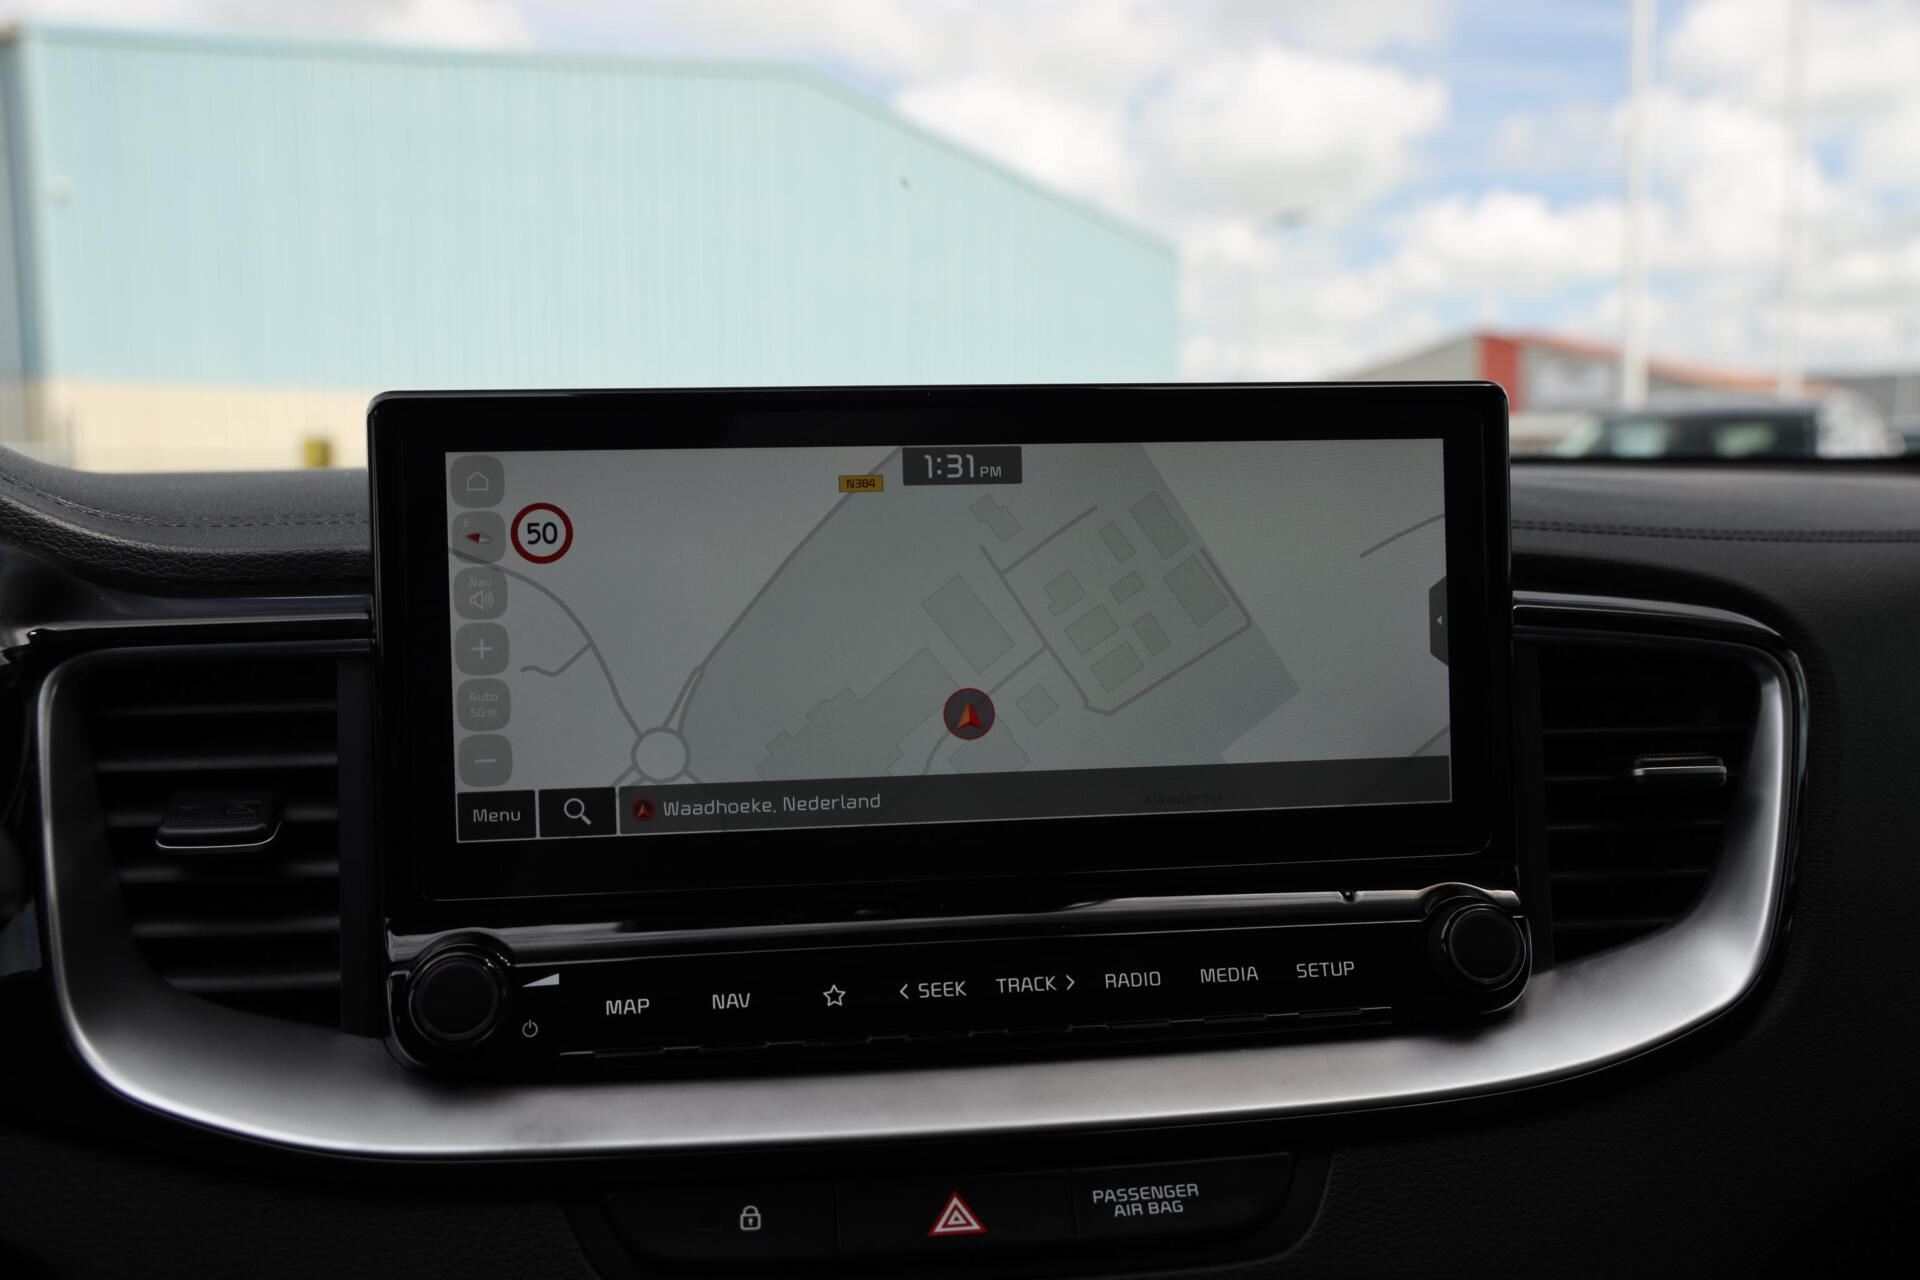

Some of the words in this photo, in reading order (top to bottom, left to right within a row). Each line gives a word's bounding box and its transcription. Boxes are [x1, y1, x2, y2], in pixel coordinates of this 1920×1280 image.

[923, 453, 975, 479] 1:31
[979, 465, 1002, 479] PM
[845, 477, 876, 489] N384
[526, 521, 558, 545] 50
[468, 691, 499, 704] Auto
[469, 707, 486, 719] 50
[487, 709, 498, 719] m
[662, 798, 778, 818] Waadhoeke,
[782, 792, 882, 812] Nederland
[472, 808, 521, 823] Menu
[1200, 966, 1259, 984] MEDIA
[1295, 960, 1355, 979] SETUP
[995, 975, 1057, 994] TRACK
[1104, 971, 1162, 989] RADIO
[917, 980, 967, 999] SEEK
[604, 998, 650, 1016] MAP
[711, 992, 751, 1010] NAV
[1092, 1183, 1200, 1204] PASSENGER
[1114, 1203, 1144, 1218] AIR
[1147, 1199, 1185, 1215] BAG
